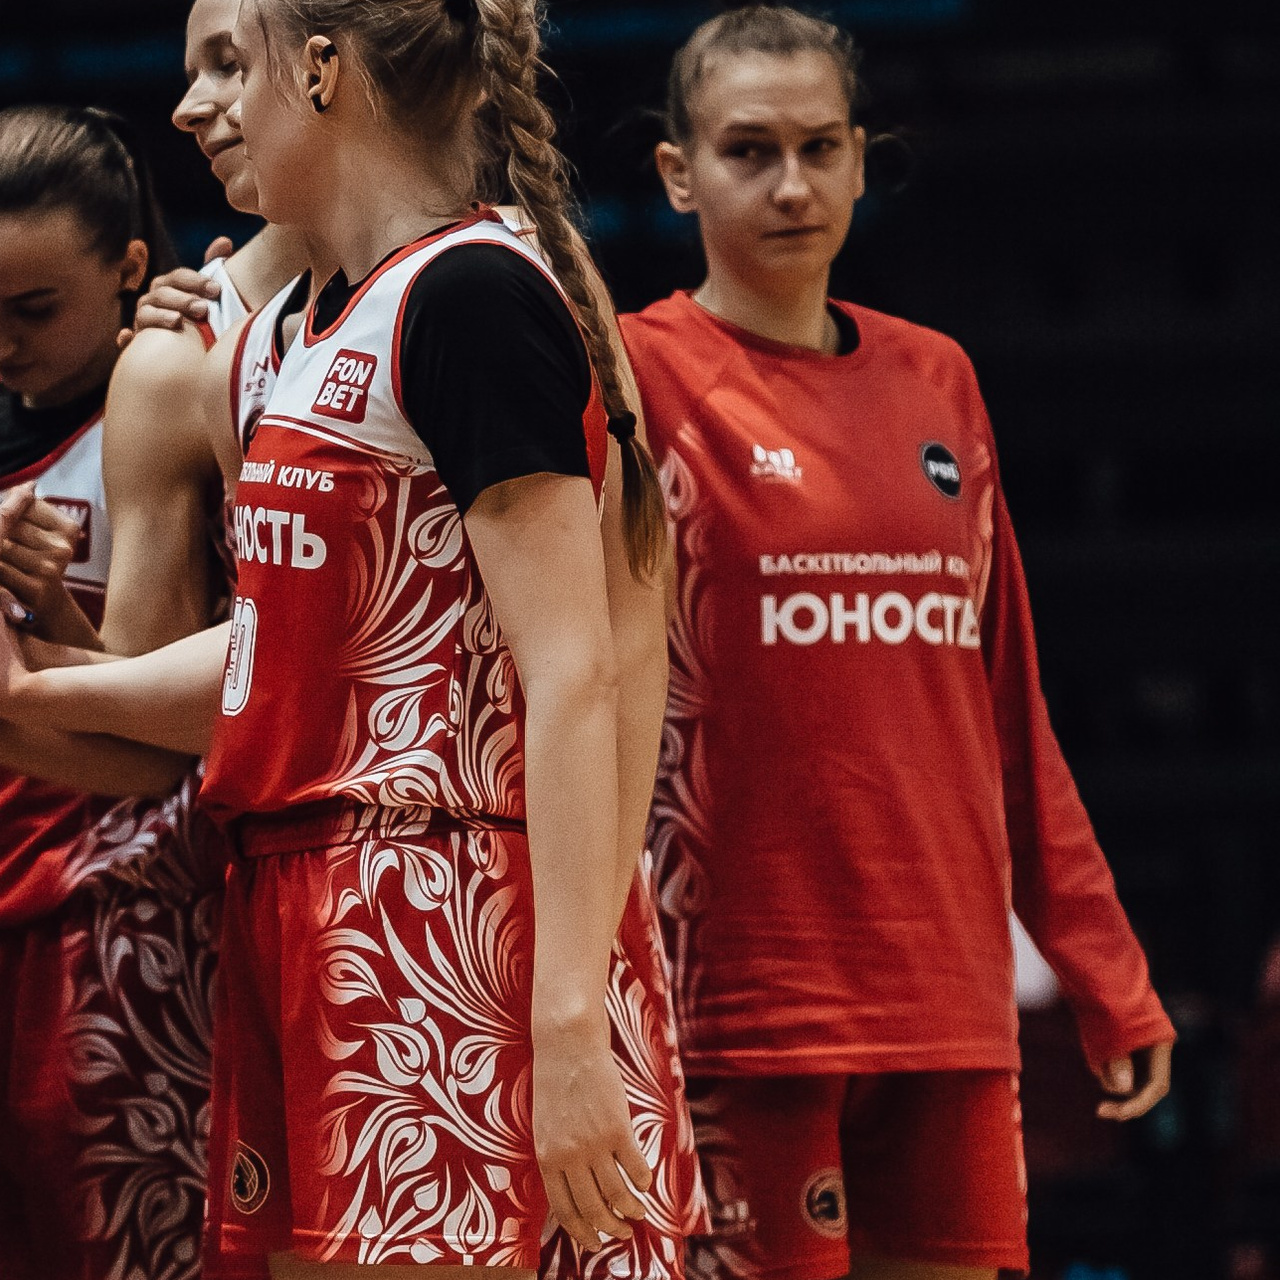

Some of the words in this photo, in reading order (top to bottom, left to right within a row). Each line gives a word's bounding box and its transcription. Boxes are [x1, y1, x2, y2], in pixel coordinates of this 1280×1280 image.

[328, 356, 372, 386] FON
[315, 382, 363, 412] BET
[277, 466, 335, 492] КЛУБ
[235, 505, 327, 570] НОСТЬ
